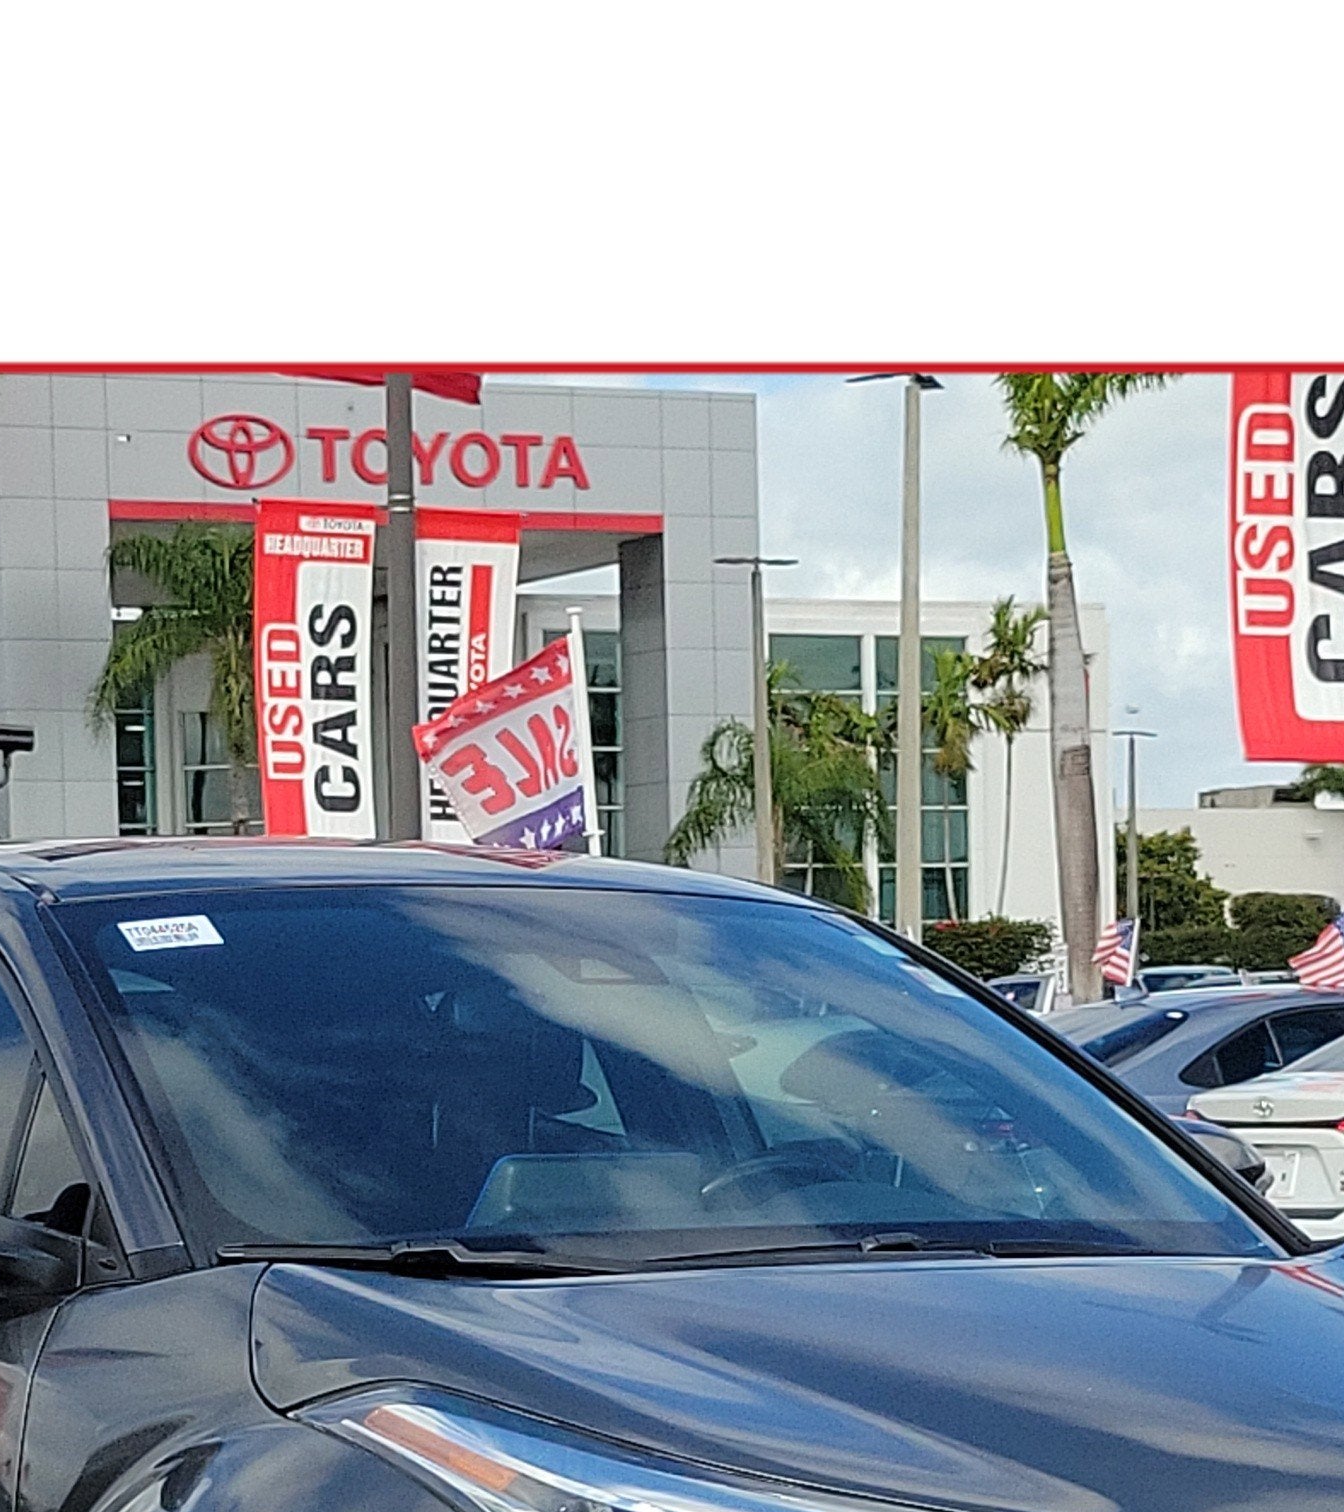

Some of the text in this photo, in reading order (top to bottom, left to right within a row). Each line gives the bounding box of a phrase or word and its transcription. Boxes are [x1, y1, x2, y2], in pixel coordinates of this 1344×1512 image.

[306, 426, 591, 491] TOYOTA
[263, 533, 364, 560] HEADQUARTER
[323, 518, 364, 531] TOYOTA
[1239, 406, 1295, 635] USED
[264, 625, 306, 778] USED
[309, 603, 361, 813] CARS
